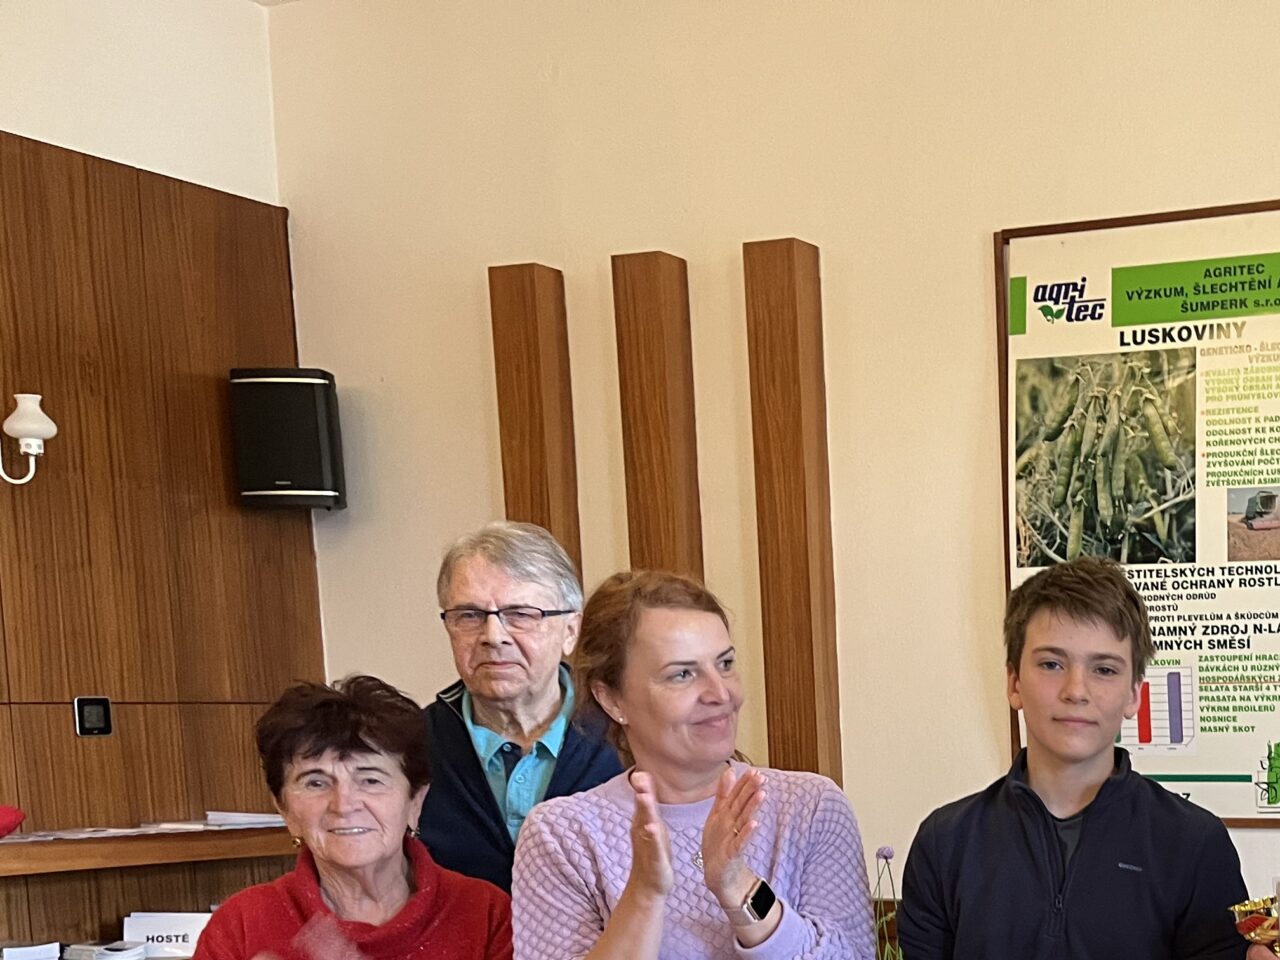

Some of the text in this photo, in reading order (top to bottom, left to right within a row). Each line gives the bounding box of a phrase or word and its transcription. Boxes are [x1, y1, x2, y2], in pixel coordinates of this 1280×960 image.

[1203, 264, 1265, 279] AGRITEC
[1033, 276, 1087, 305] agri
[1126, 286, 1189, 301] VÝZKUM,
[1193, 276, 1272, 296] ŠLECHTĚNÍ
[1063, 294, 1105, 322] tec
[1180, 297, 1248, 313] ŠUMPERK
[1119, 321, 1247, 347] LUSKOVINY
[1206, 418, 1252, 427] ODOLNOST
[1206, 428, 1252, 437] ODOLNOST
[1255, 425, 1266, 434] KE
[1206, 447, 1257, 459] PRODUKČNÍ
[1206, 459, 1255, 468] ZVYŠOVÁNÍ
[1127, 565, 1215, 579] STITELSKÝCH
[1135, 579, 1167, 591] VANÉ
[1171, 578, 1234, 590] OCHRANY
[1186, 592, 1216, 600] ODRŮD
[1177, 613, 1223, 621] PLEVELŮM
[1202, 624, 1248, 635] ZDROJ
[1208, 636, 1251, 650] SMĚSÍ
[1199, 653, 1253, 663] ZASTOUPENÍ
[1199, 664, 1240, 672] DÁVKÁCH
[1232, 682, 1263, 691] STARŠÍ
[1199, 703, 1275, 713] VÝKRM BROILERŮ
[1200, 715, 1237, 723] NOSNICE
[1200, 725, 1230, 733] MASNÝ
[146, 933, 189, 943] HOSTÉ
